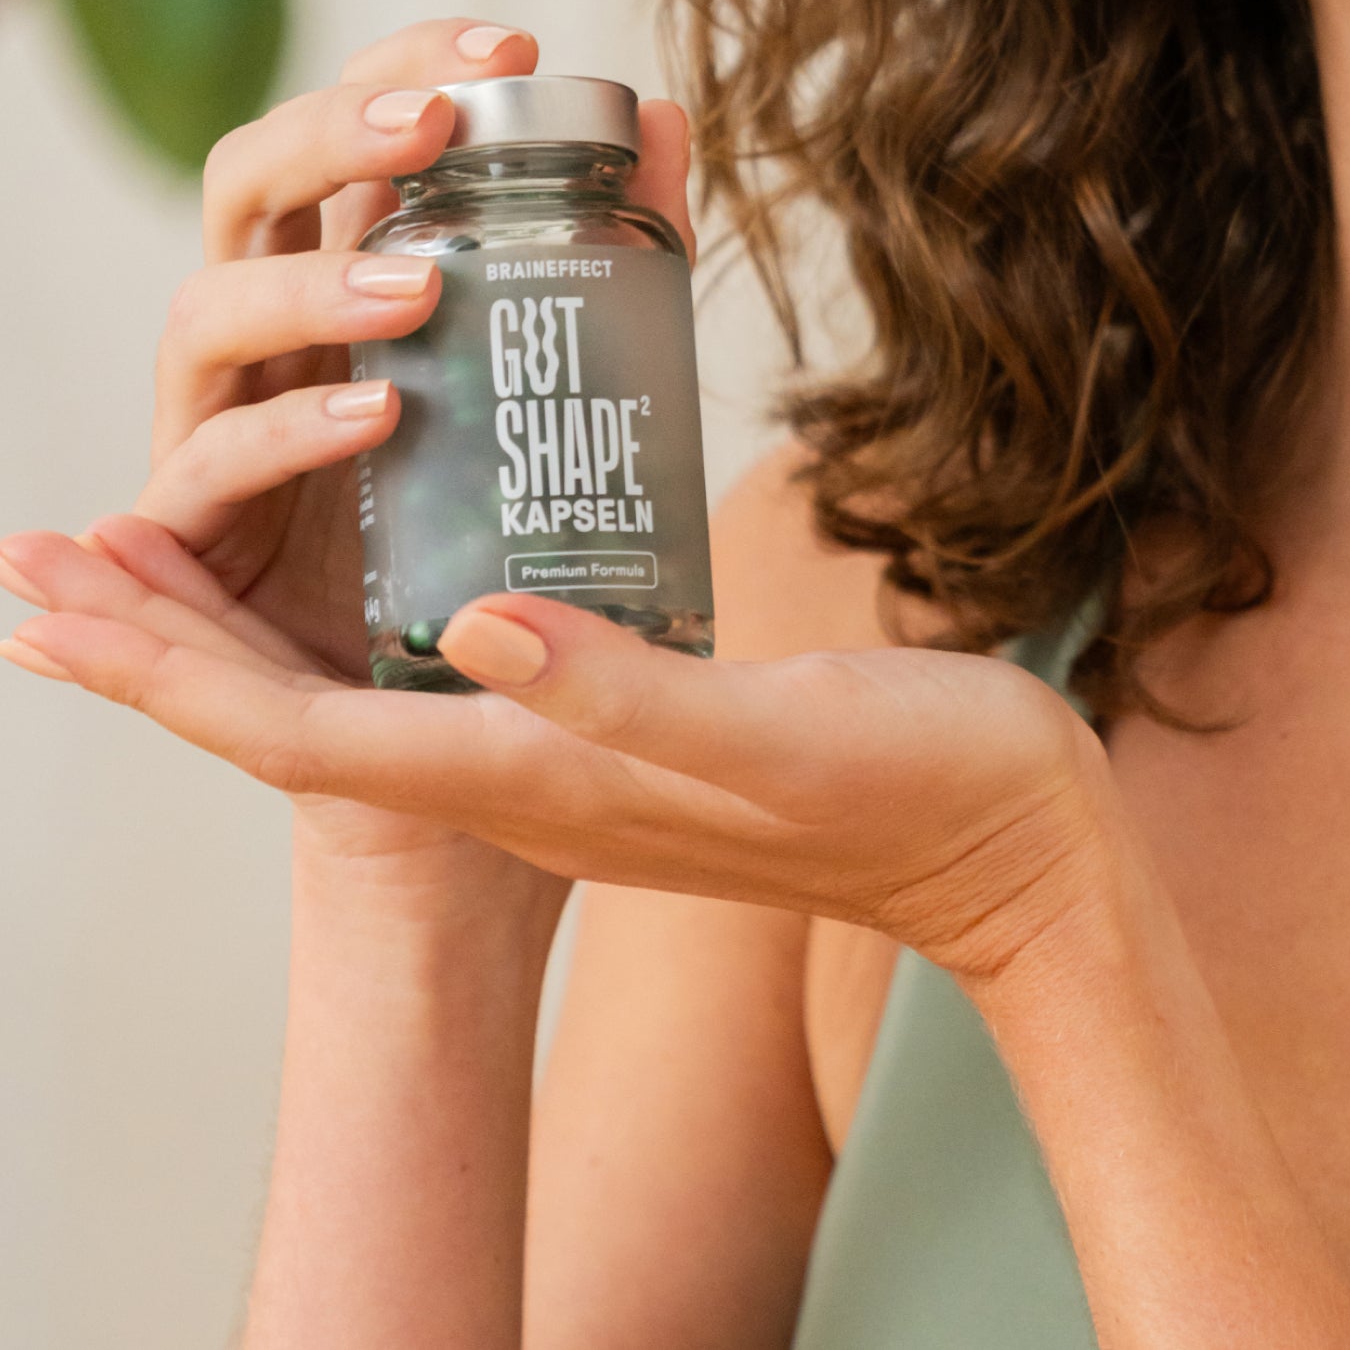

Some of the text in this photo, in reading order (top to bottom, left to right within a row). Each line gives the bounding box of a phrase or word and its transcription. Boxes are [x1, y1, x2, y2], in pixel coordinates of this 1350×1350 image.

[486, 259, 612, 281] BRAINEFFECT
[490, 296, 584, 398] GUT
[501, 499, 654, 536] KAPSELN
[521, 562, 645, 580] Premium Formula
